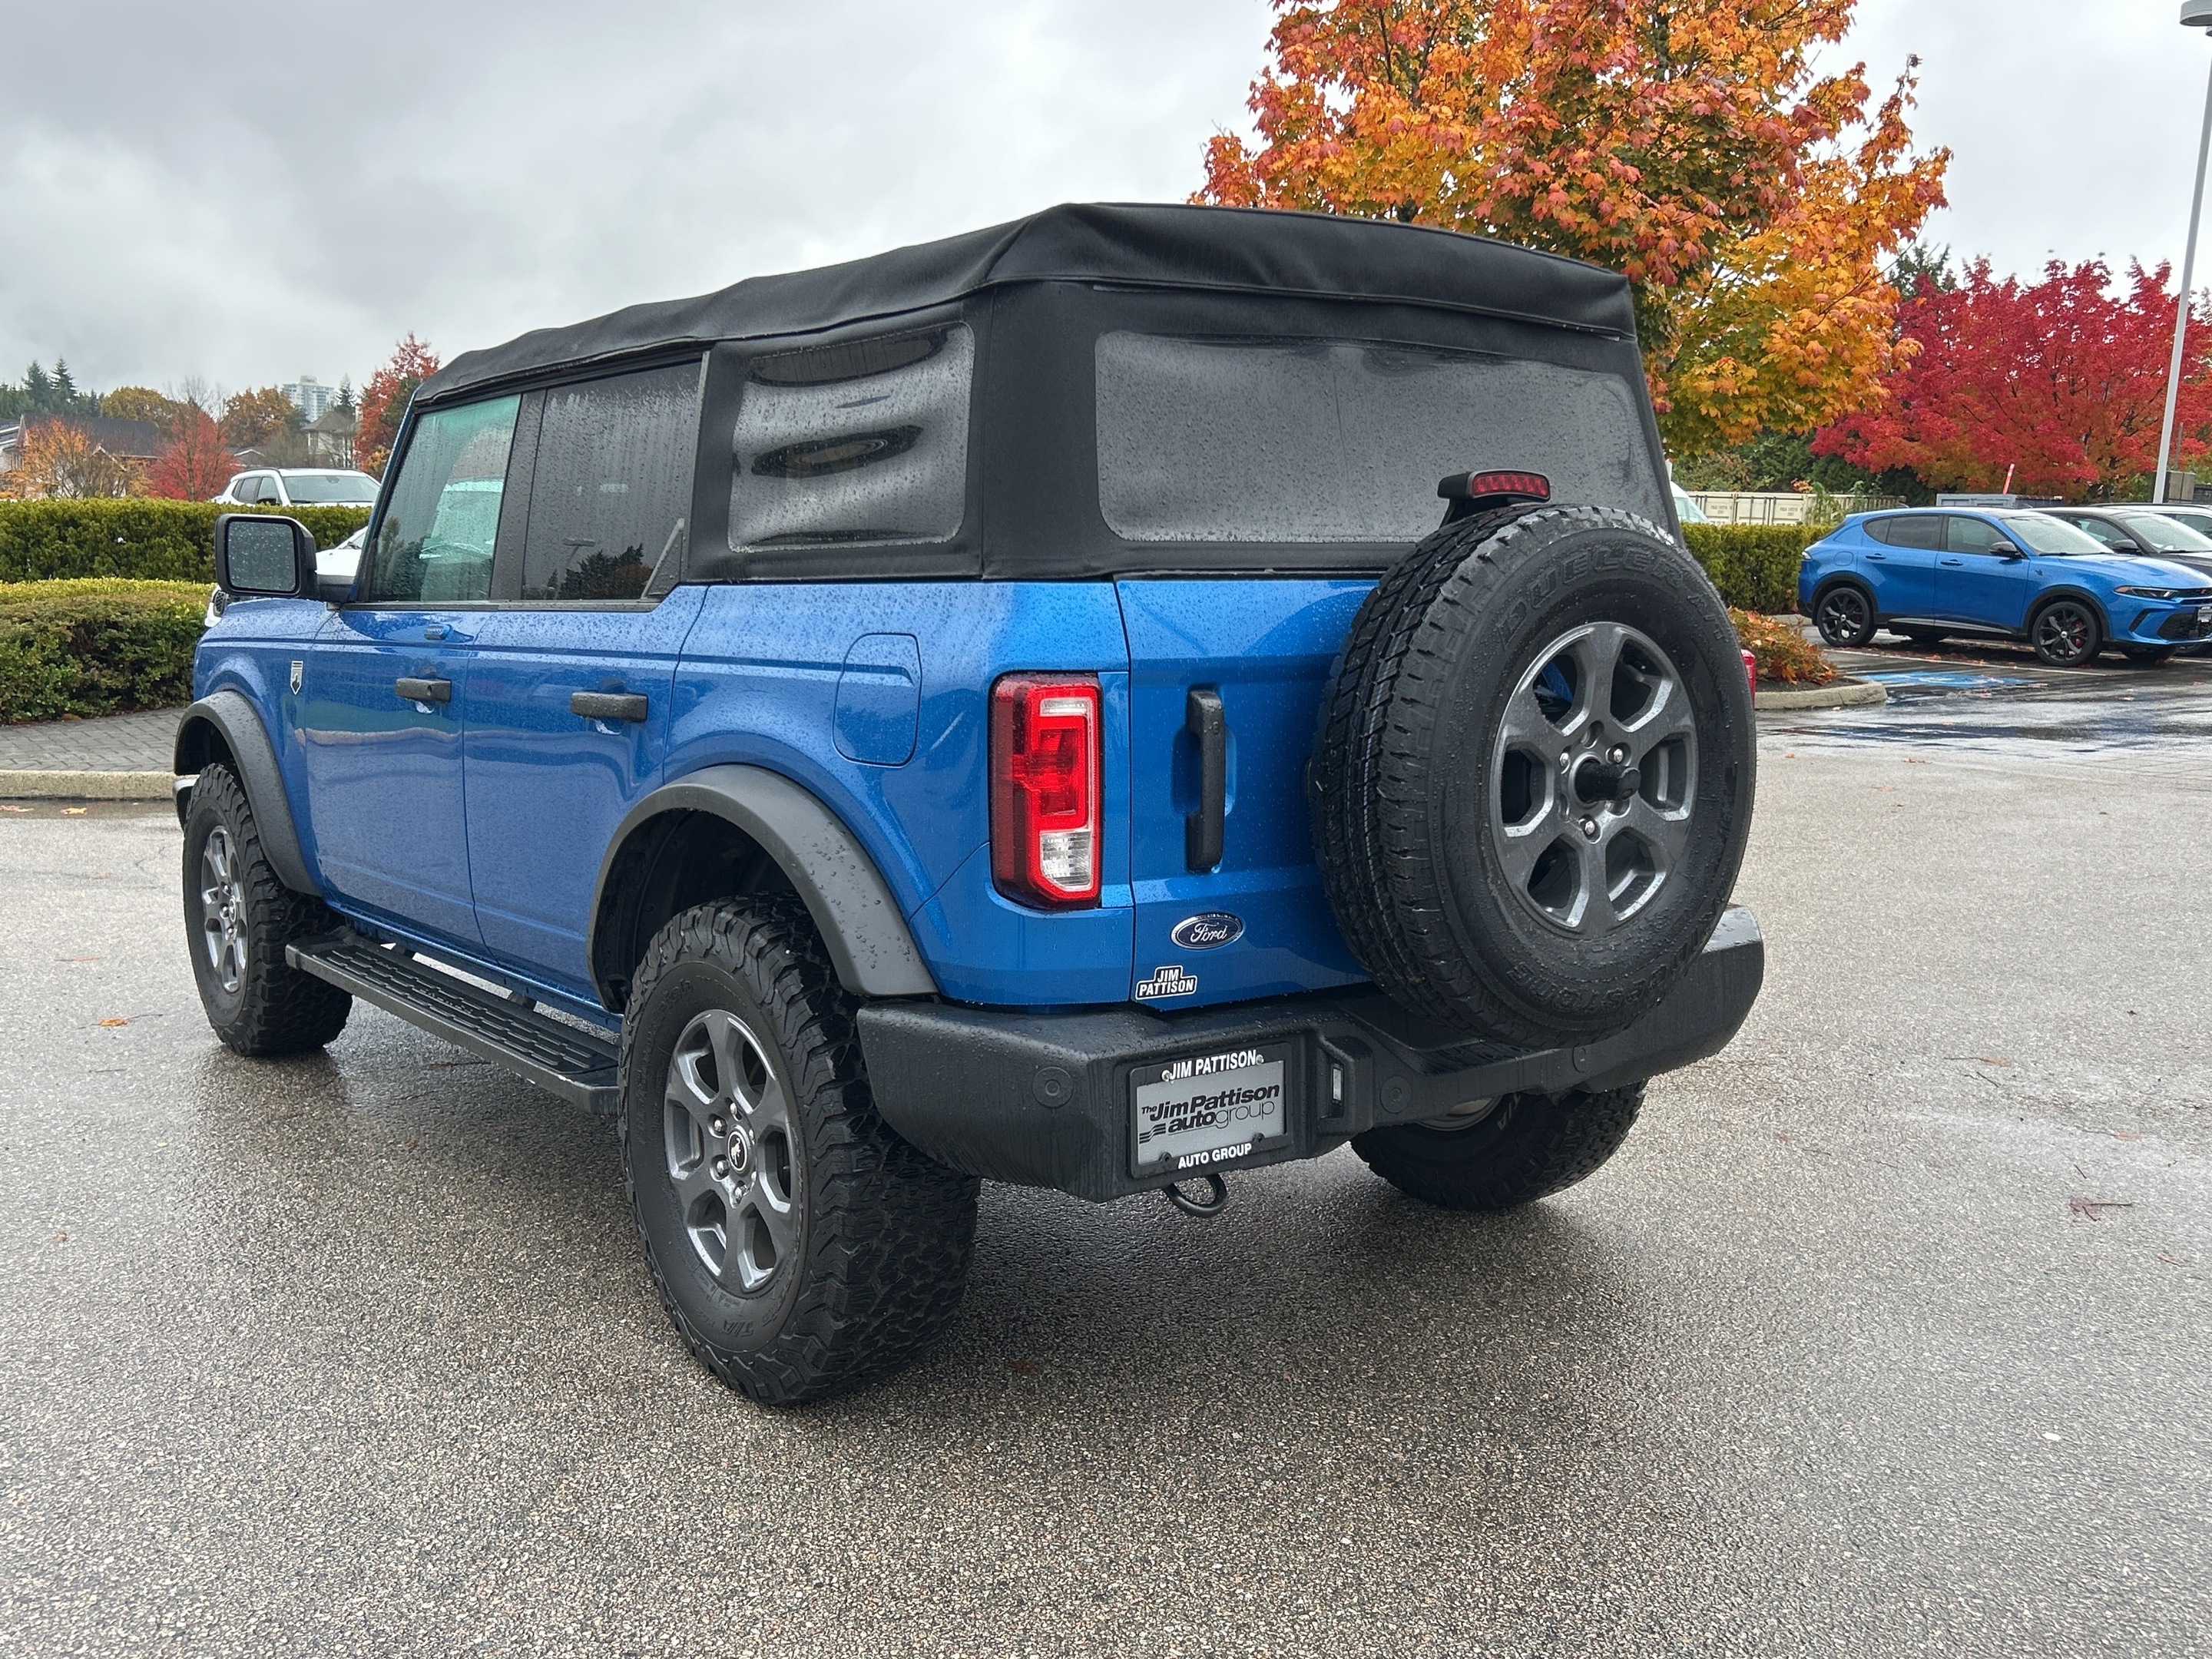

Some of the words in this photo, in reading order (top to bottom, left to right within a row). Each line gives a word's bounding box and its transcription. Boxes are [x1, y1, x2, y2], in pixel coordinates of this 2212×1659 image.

[1498, 546, 1683, 650] DUELER
[1190, 922, 1228, 943] Ford
[1139, 979, 1194, 996] PATTISON
[1157, 969, 1179, 983] JIM
[1170, 1060, 1191, 1081] JIM
[1195, 1049, 1257, 1075] PATTISON
[1141, 1105, 1157, 1114] The
[1150, 1100, 1189, 1121] Jim
[1190, 1084, 1280, 1113] Pattison
[1177, 1152, 1210, 1169] AUTO
[1212, 1143, 1253, 1162] GROUP
